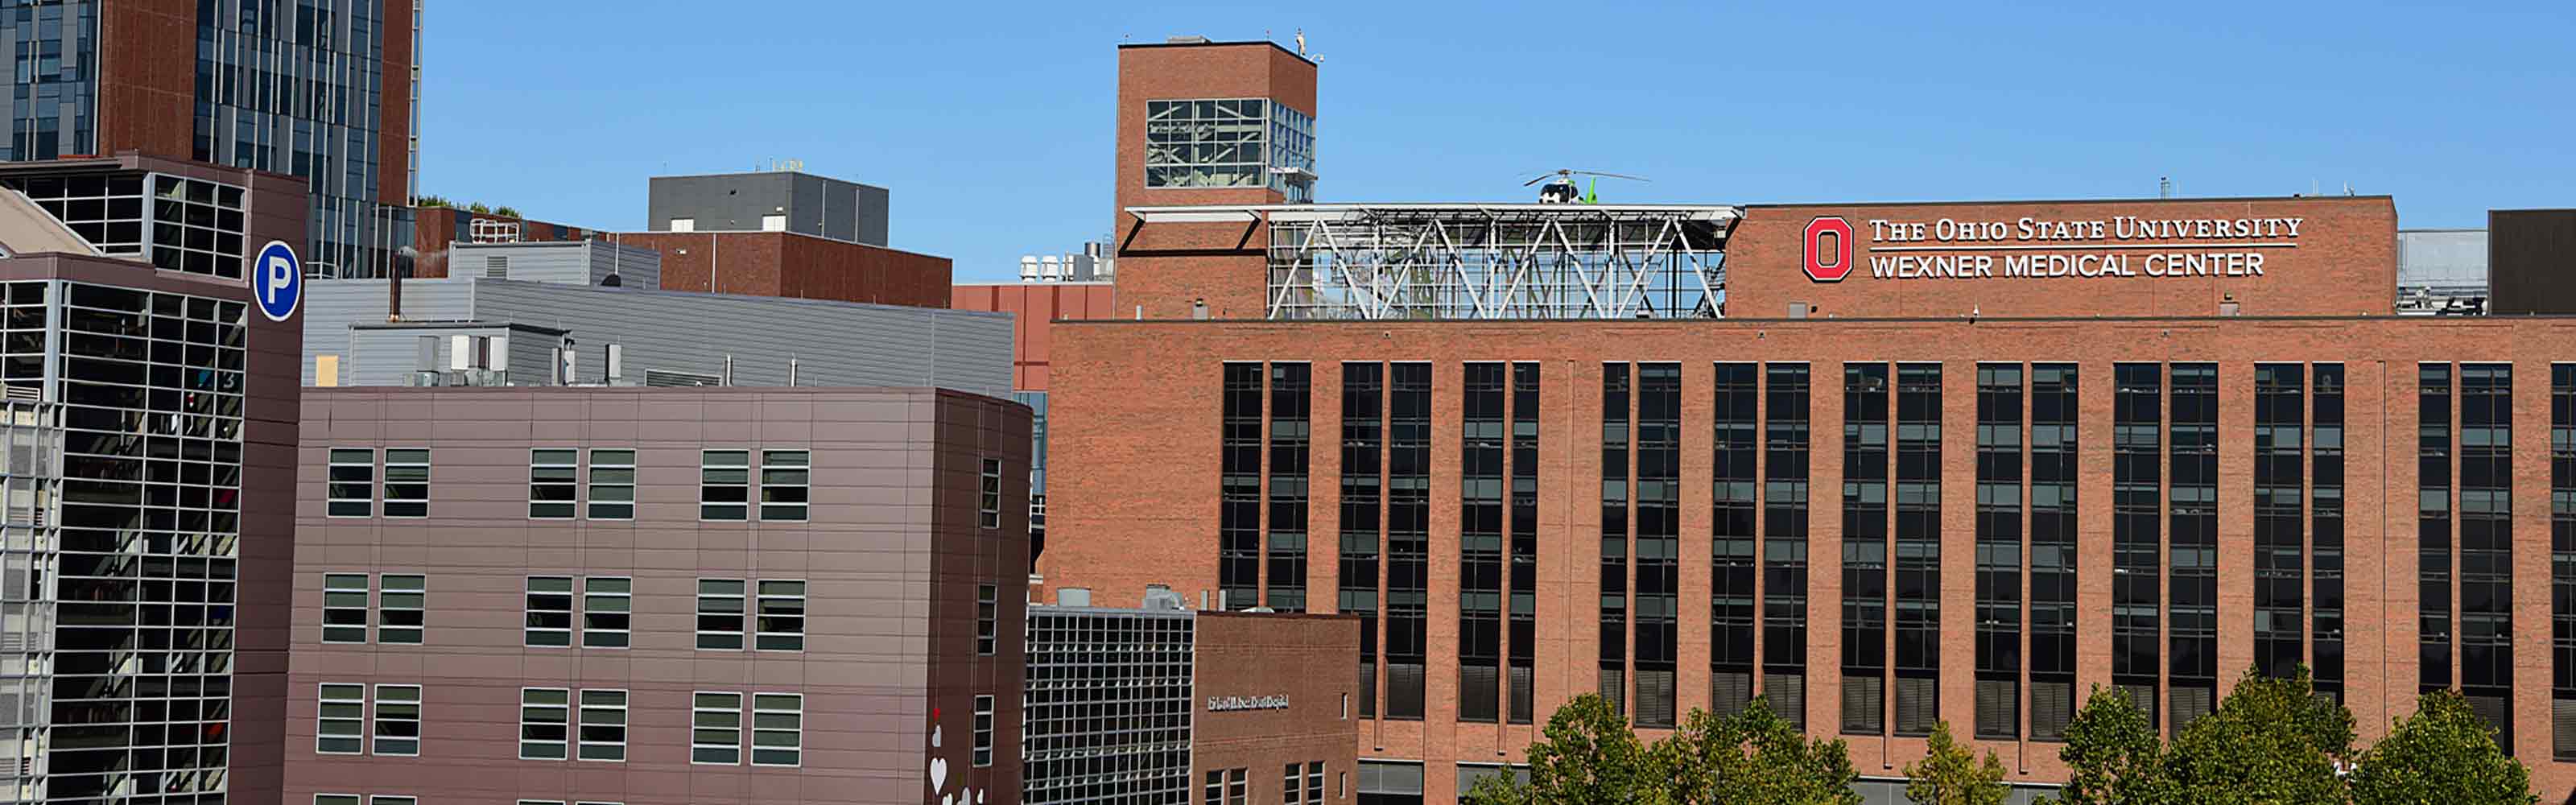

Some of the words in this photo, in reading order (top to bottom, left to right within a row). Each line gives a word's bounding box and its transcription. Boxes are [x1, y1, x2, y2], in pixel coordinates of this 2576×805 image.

[1803, 217, 1853, 281] O
[1869, 255, 1992, 277] WEXNER
[2005, 254, 2136, 276] MEDICAL
[2145, 253, 2264, 275] CENTER
[268, 255, 291, 303] P
